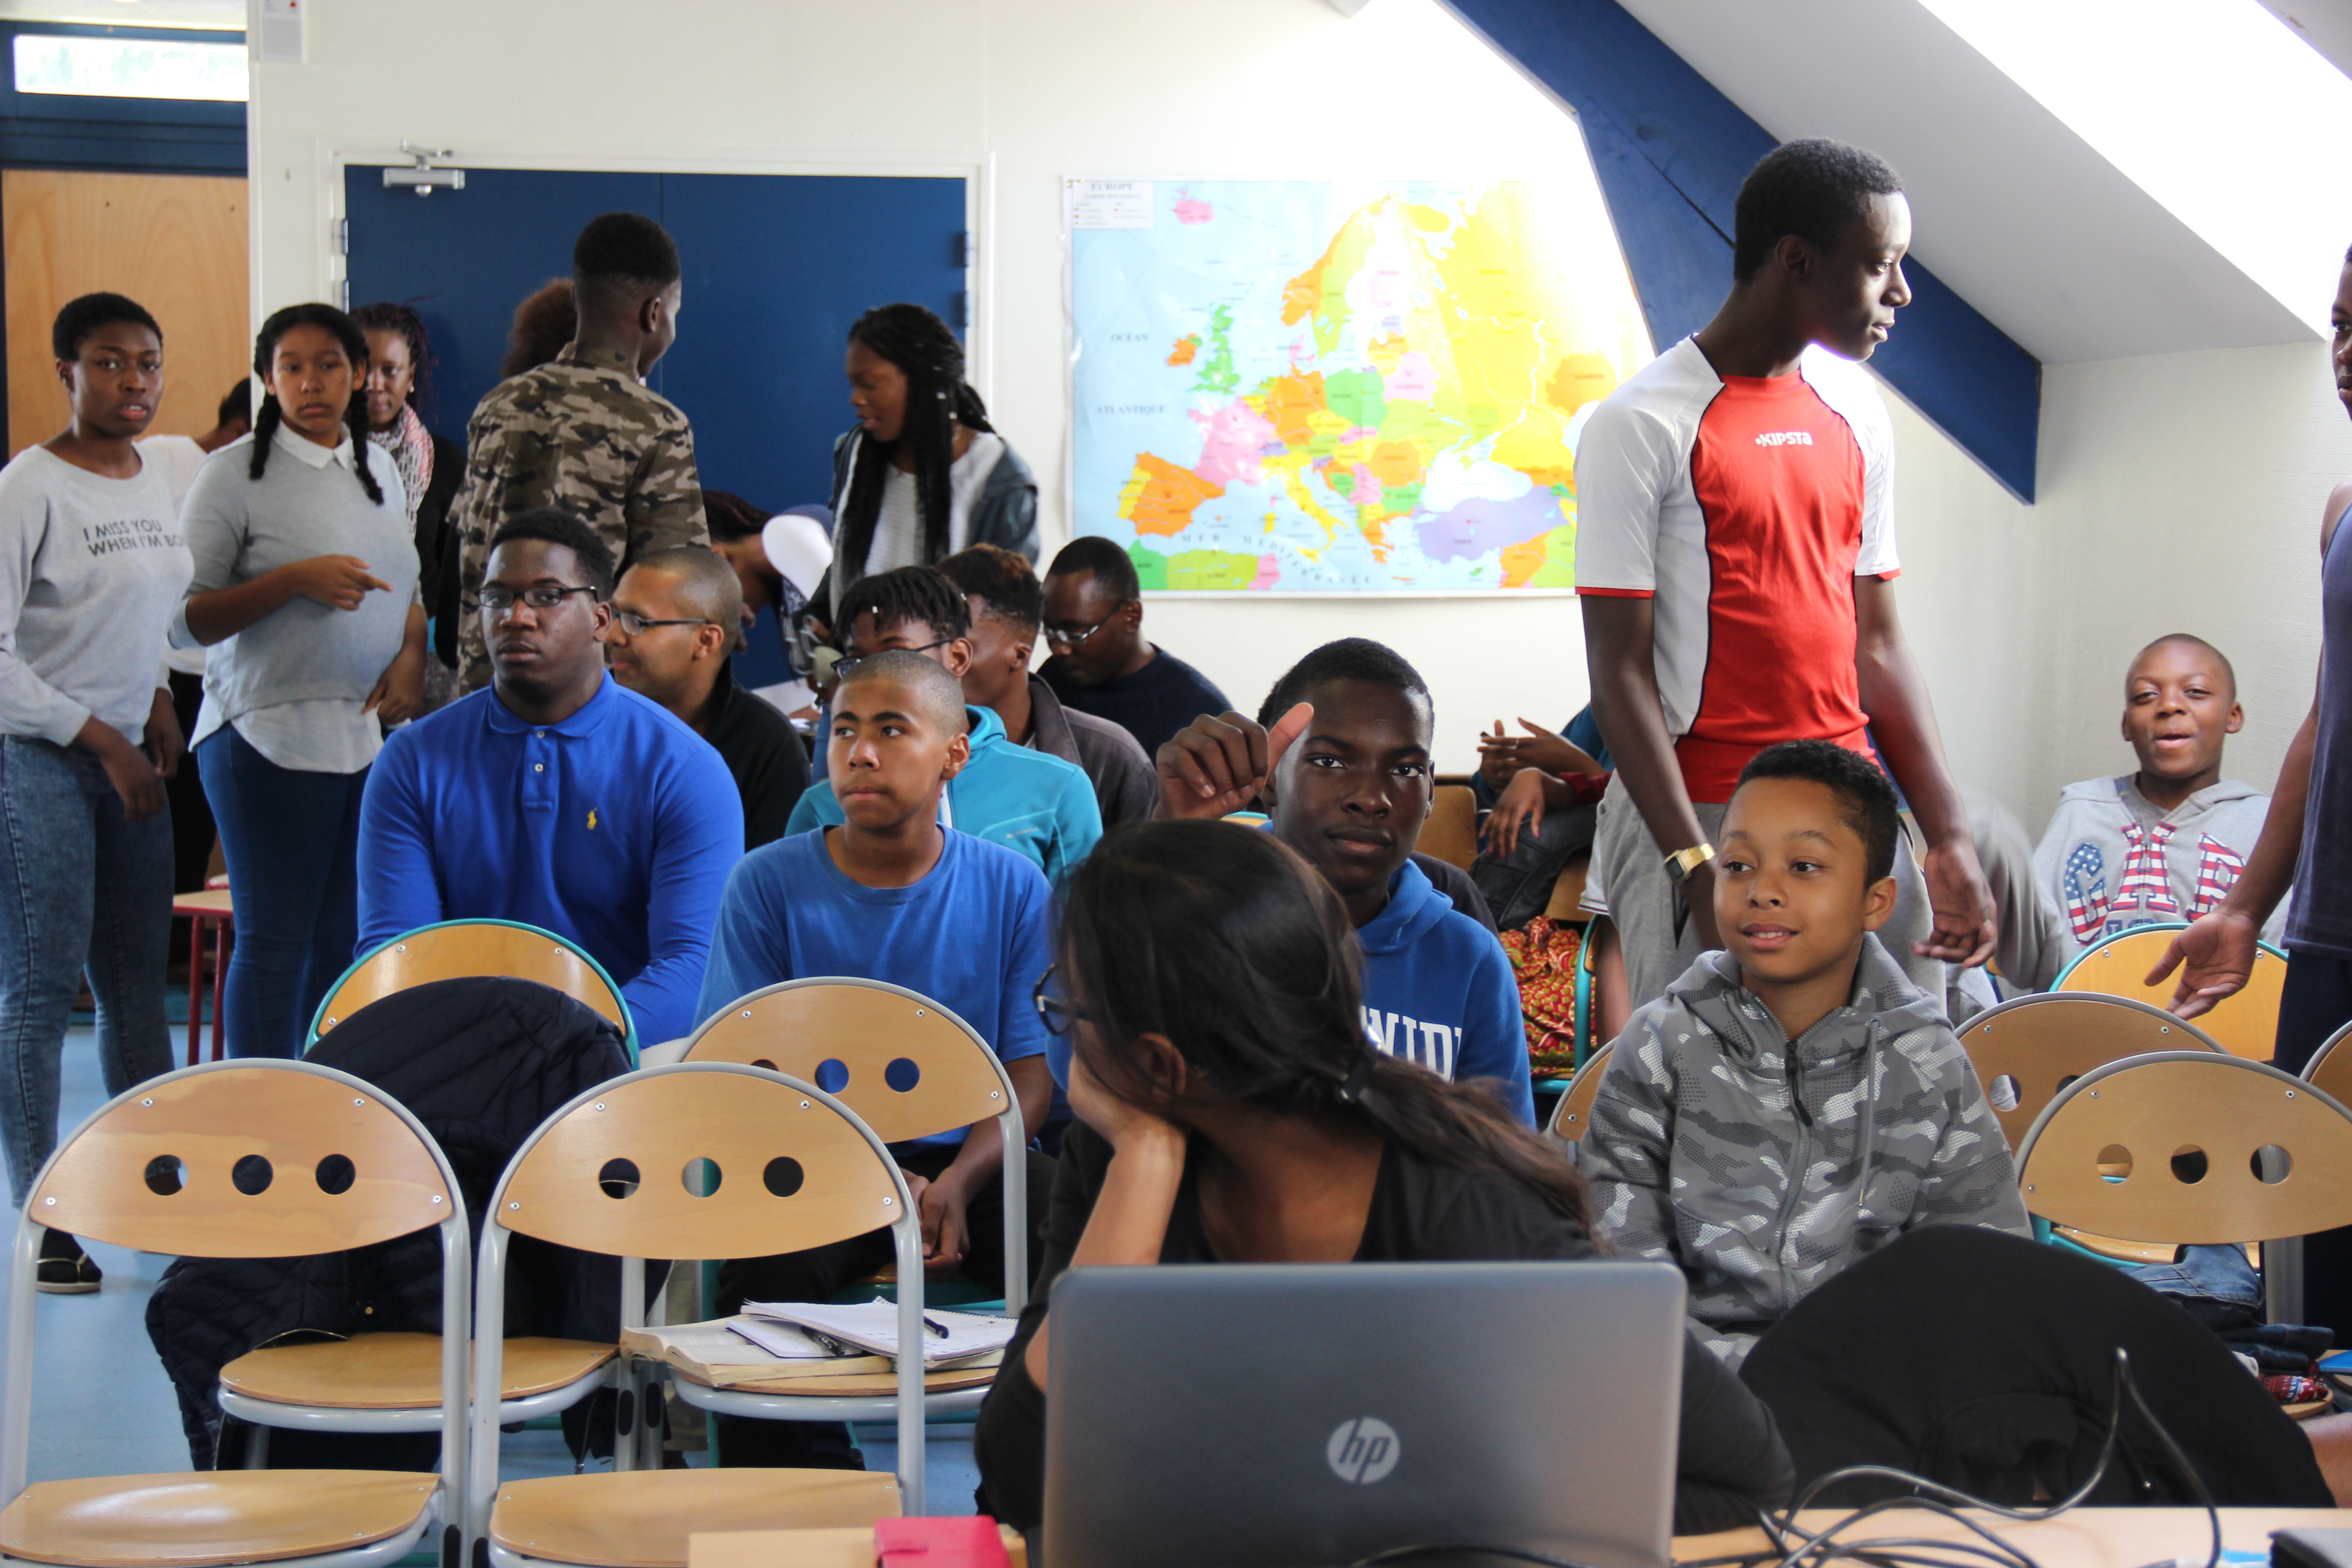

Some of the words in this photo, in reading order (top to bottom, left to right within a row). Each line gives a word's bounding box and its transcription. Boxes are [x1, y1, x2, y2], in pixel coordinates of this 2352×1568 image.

[1111, 331, 1148, 342] OCÉAN
[1097, 405, 1166, 415] ATLANTIQUE
[83, 527, 89, 541] I
[95, 520, 130, 538] MISS
[130, 519, 162, 533] YOU
[88, 536, 139, 557] WHEN
[141, 535, 163, 549] I'M
[164, 534, 184, 547] BO
[1182, 534, 1220, 543] MER
[1336, 1416, 1392, 1485] hp
